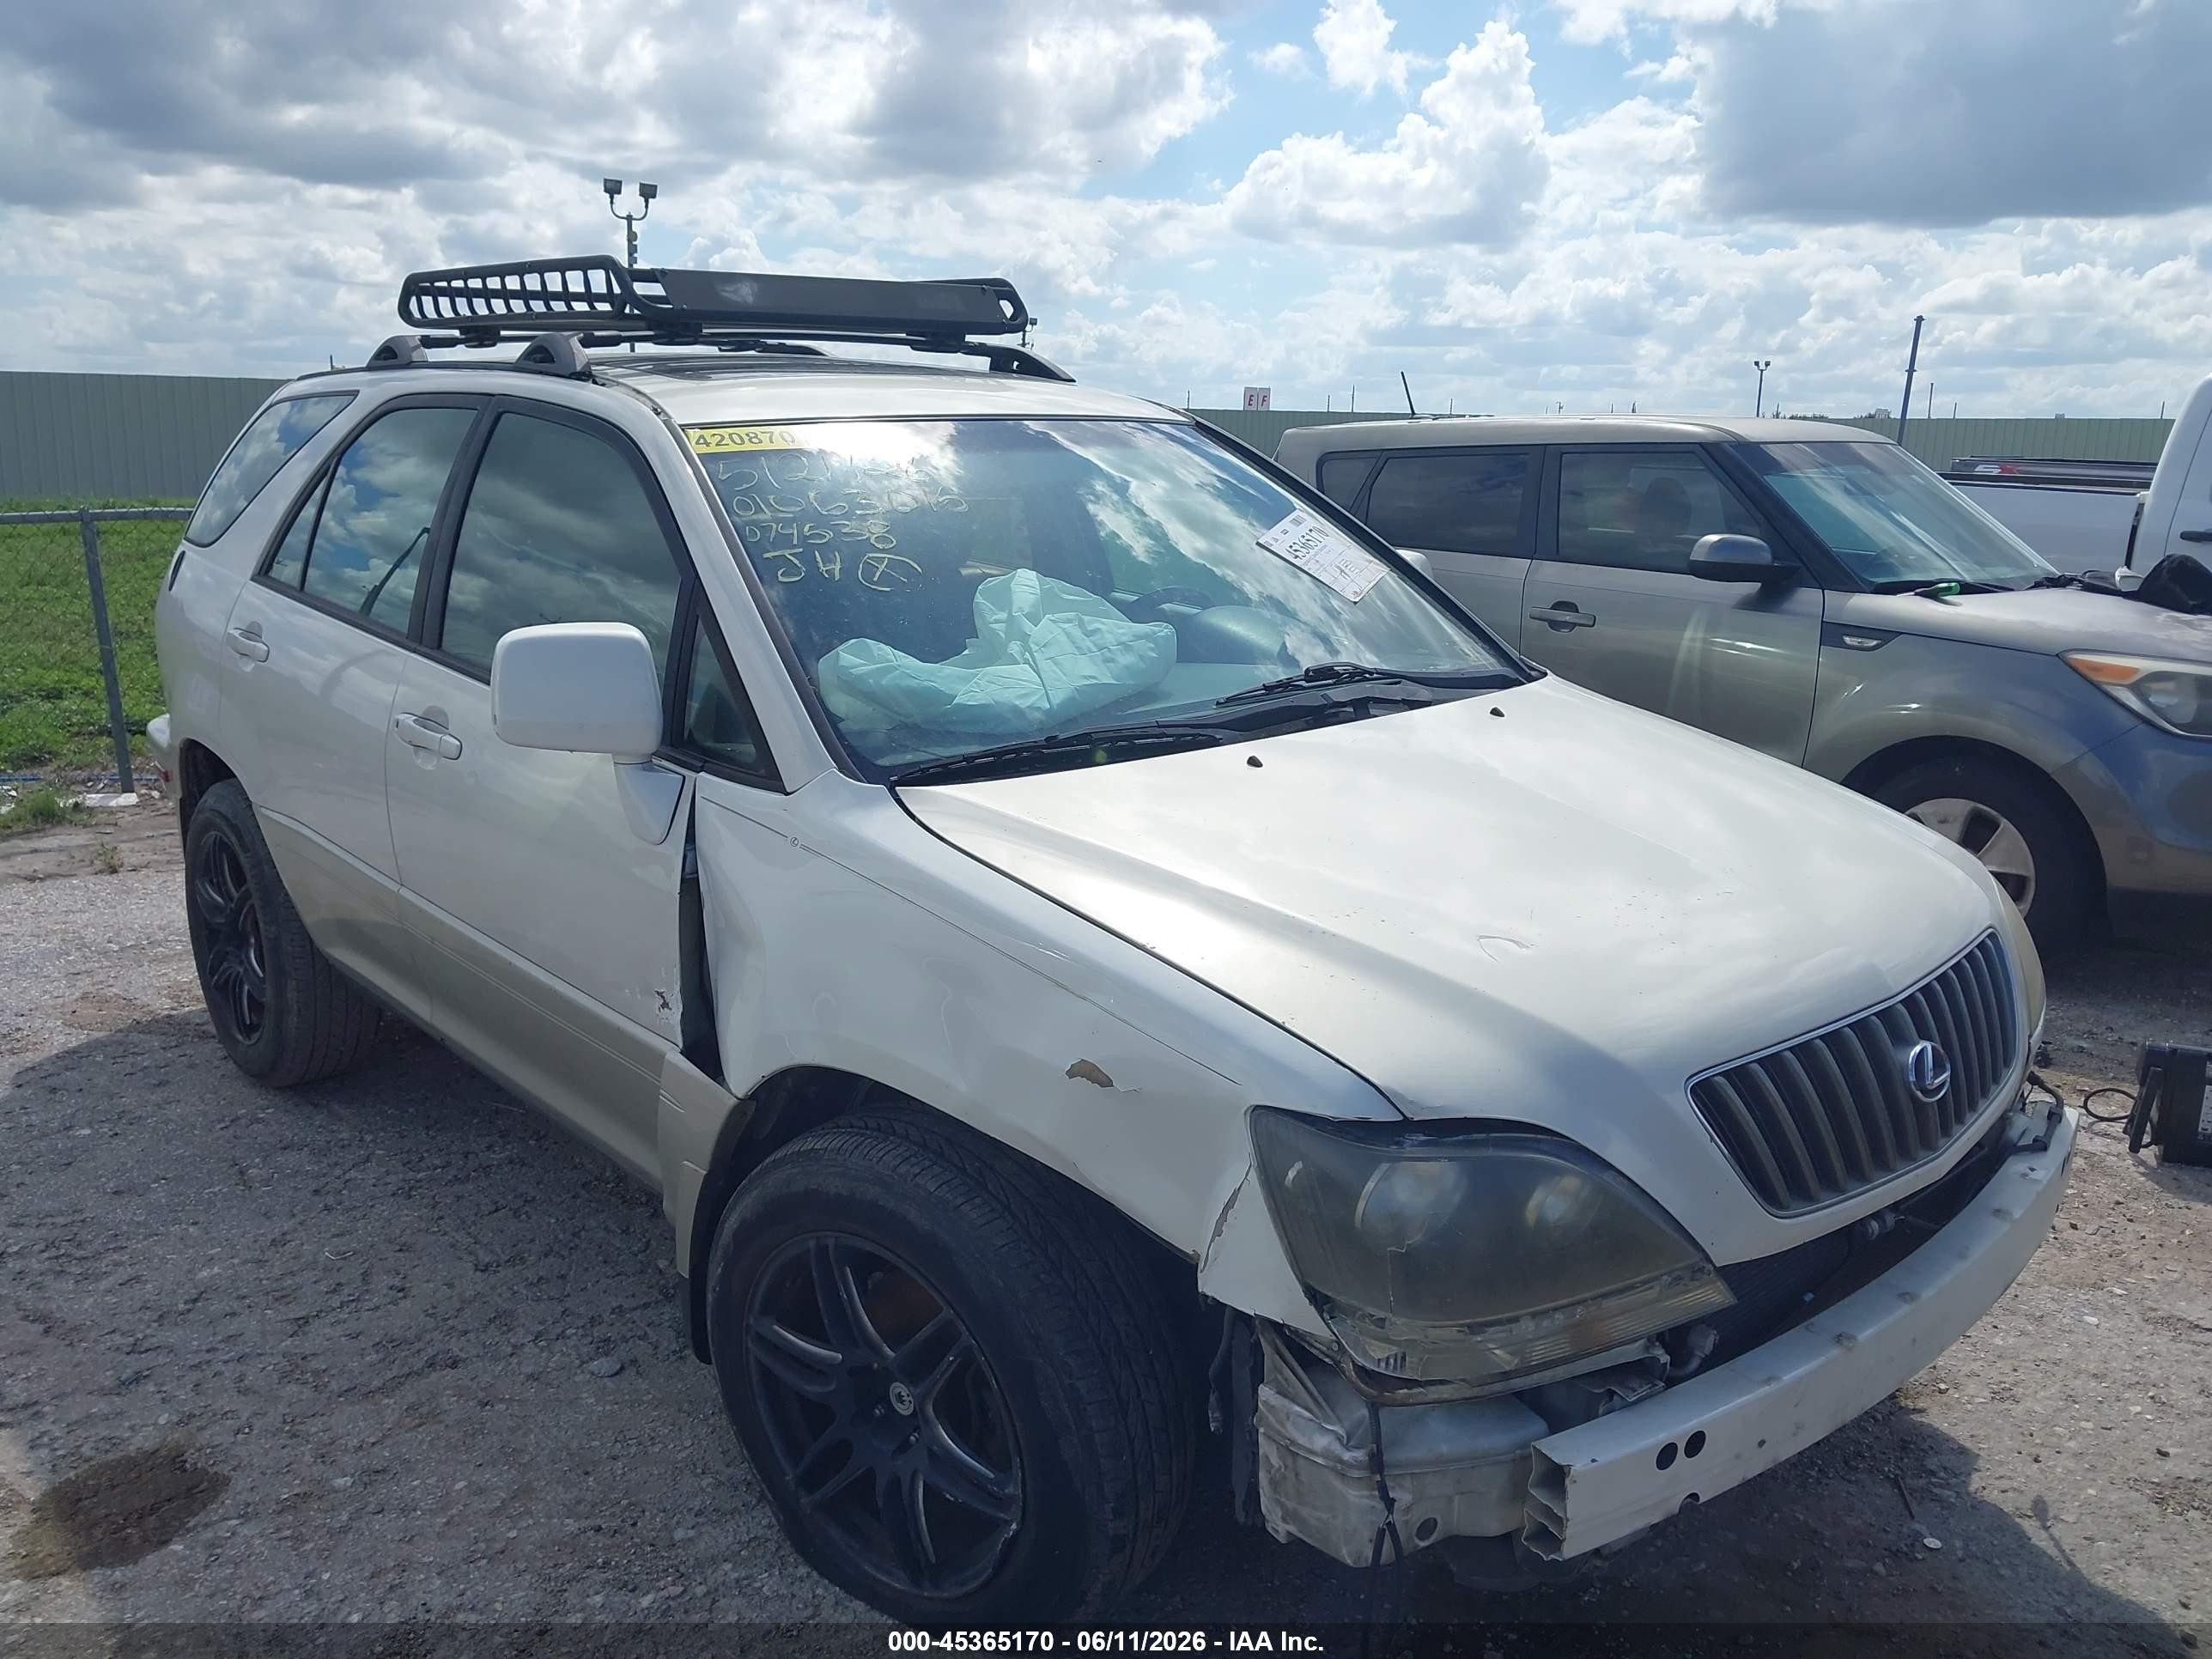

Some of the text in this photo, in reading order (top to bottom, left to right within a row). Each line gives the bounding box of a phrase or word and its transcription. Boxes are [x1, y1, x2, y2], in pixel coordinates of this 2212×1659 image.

[1248, 395, 1255, 406] E
[1261, 395, 1268, 407] F
[1285, 526, 1330, 560] 45365170
